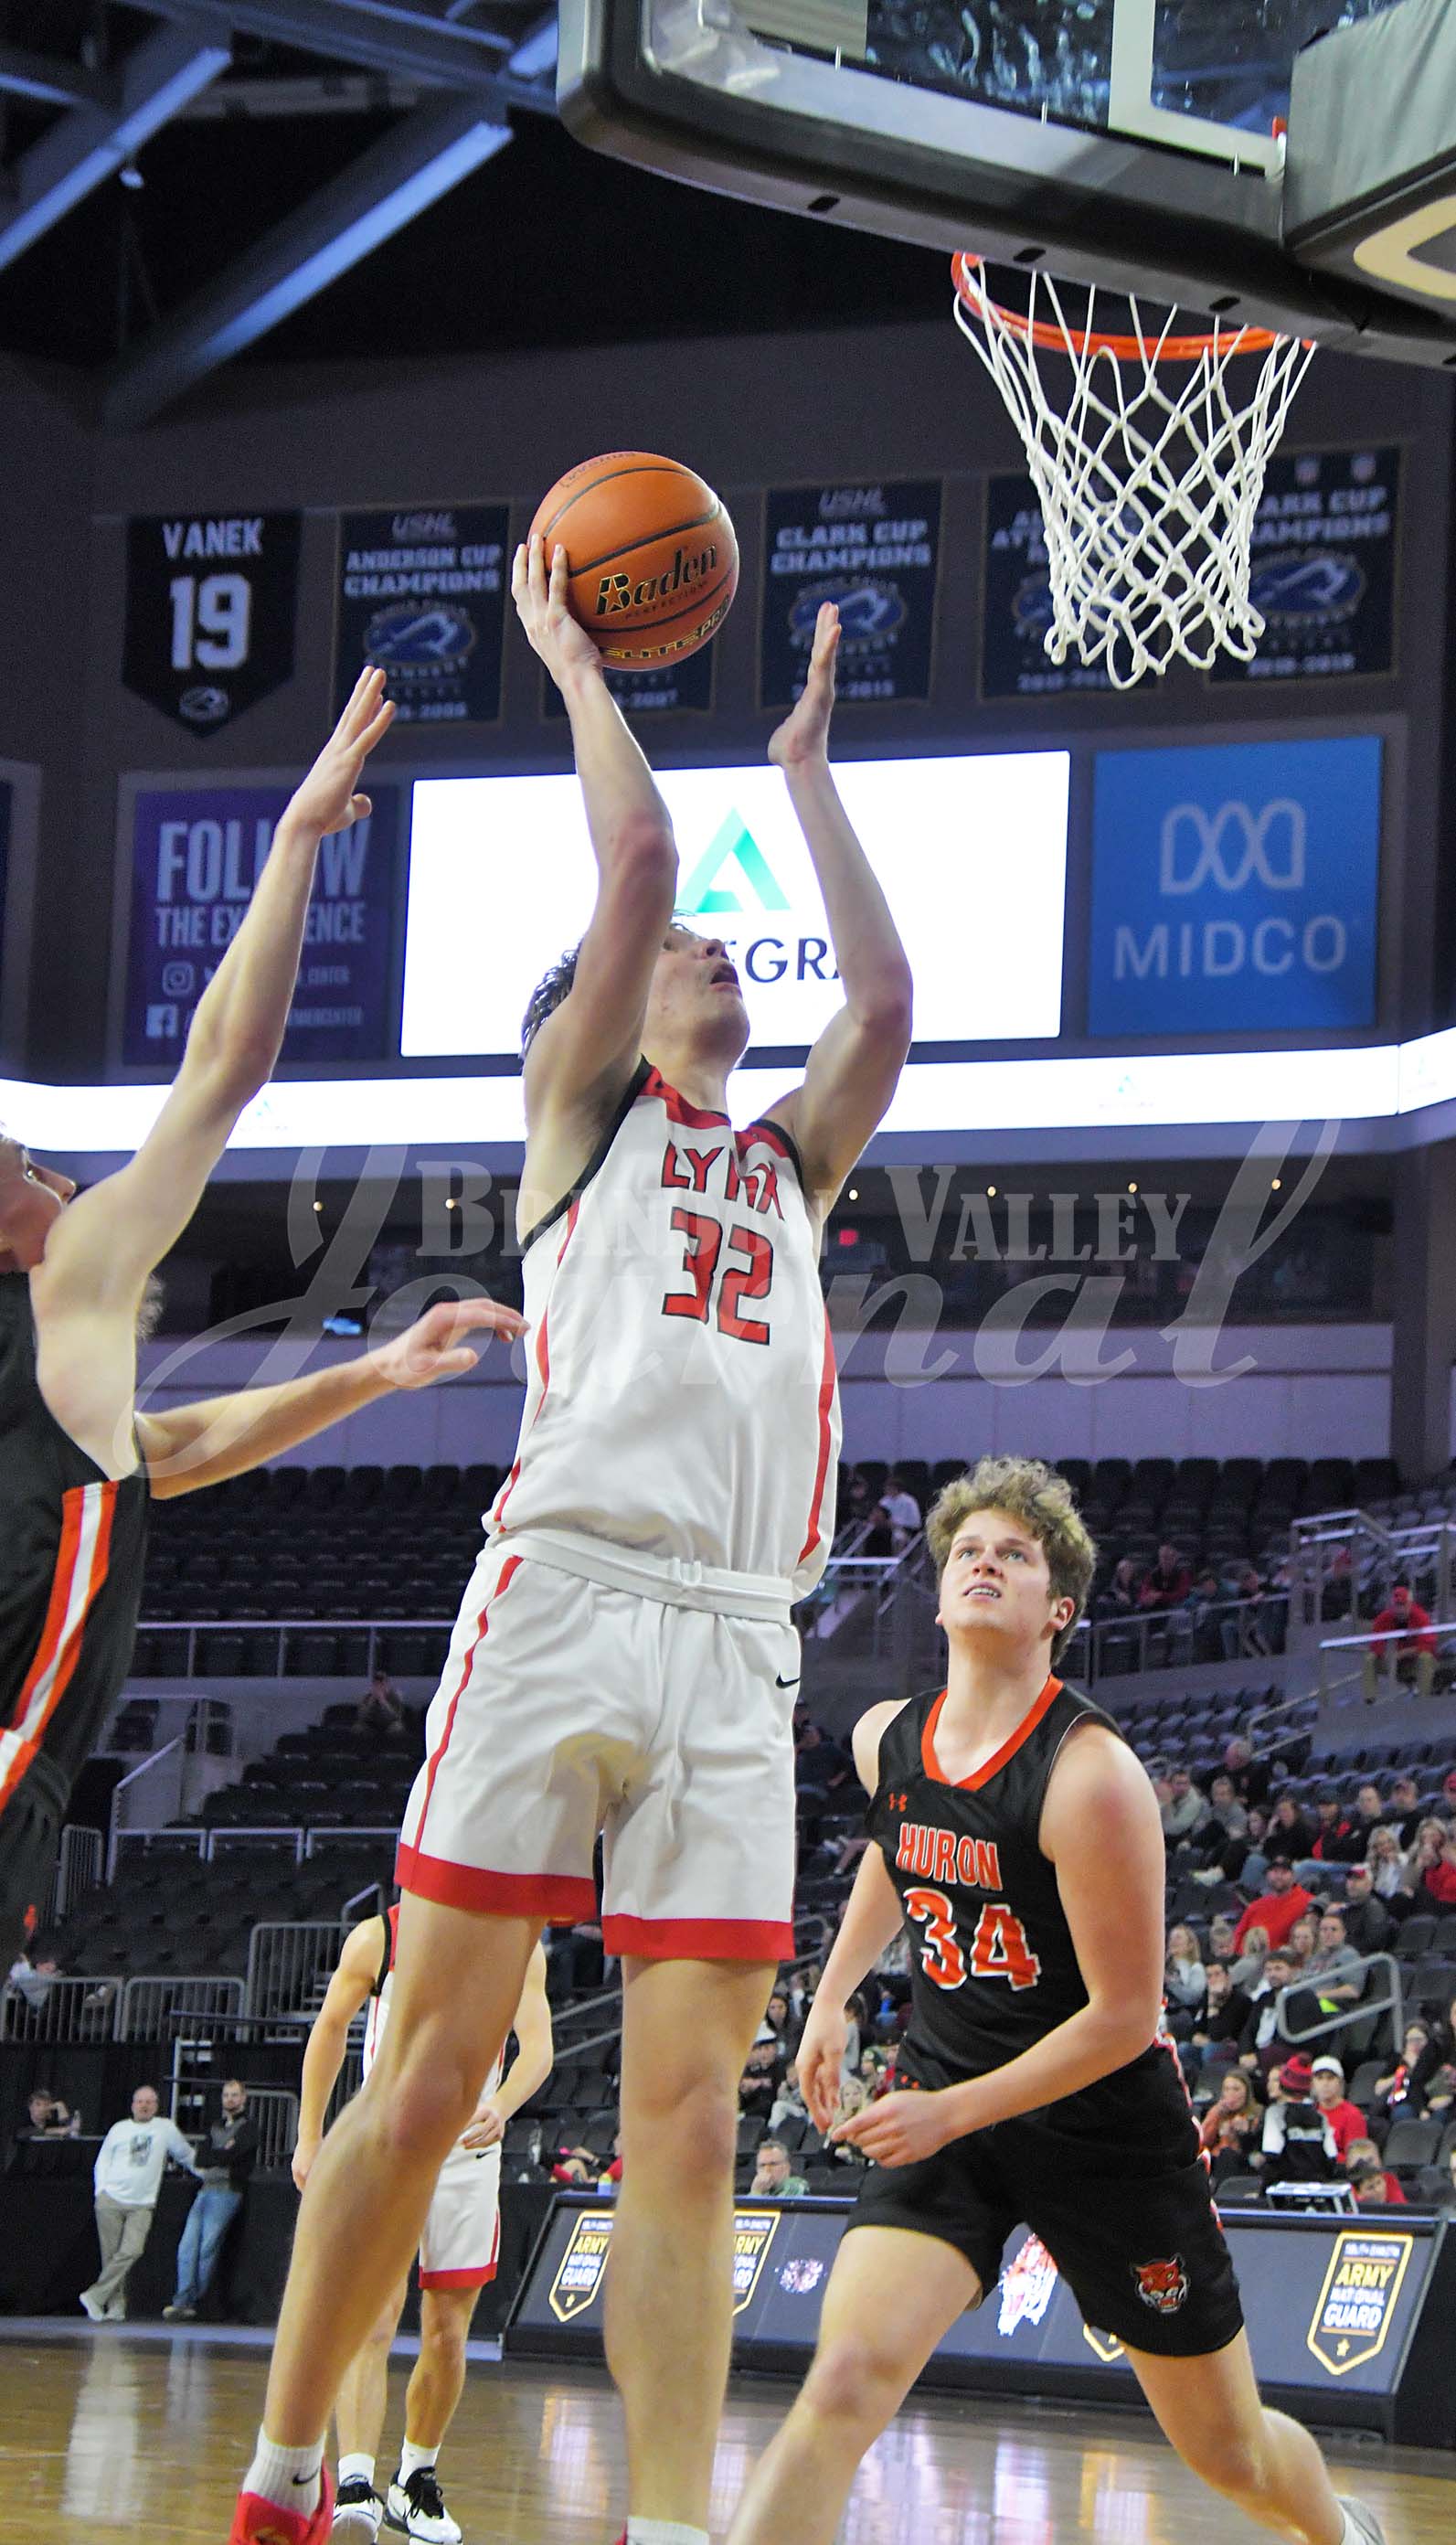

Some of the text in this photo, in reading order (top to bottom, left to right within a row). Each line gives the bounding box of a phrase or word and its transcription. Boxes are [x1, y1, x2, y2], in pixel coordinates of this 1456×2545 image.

[162, 518, 264, 559] VANEK
[872, 518, 929, 543] CUP
[460, 544, 502, 566] CUP
[770, 543, 932, 574] CHAMPIONS
[343, 568, 501, 600] CHAMPIONS
[596, 544, 717, 616] Baden
[170, 572, 251, 670] 19
[155, 904, 206, 948] THE
[1113, 915, 1348, 980] MIDCO
[661, 1206, 774, 1347] 32
[896, 1822, 1004, 1891] HURON
[903, 1887, 1042, 1992] 34
[573, 2236, 610, 2254] ARMY
[733, 2235, 766, 2255] RMY
[1334, 2263, 1395, 2288] ARMY
[1323, 2303, 1384, 2330] GUARD
